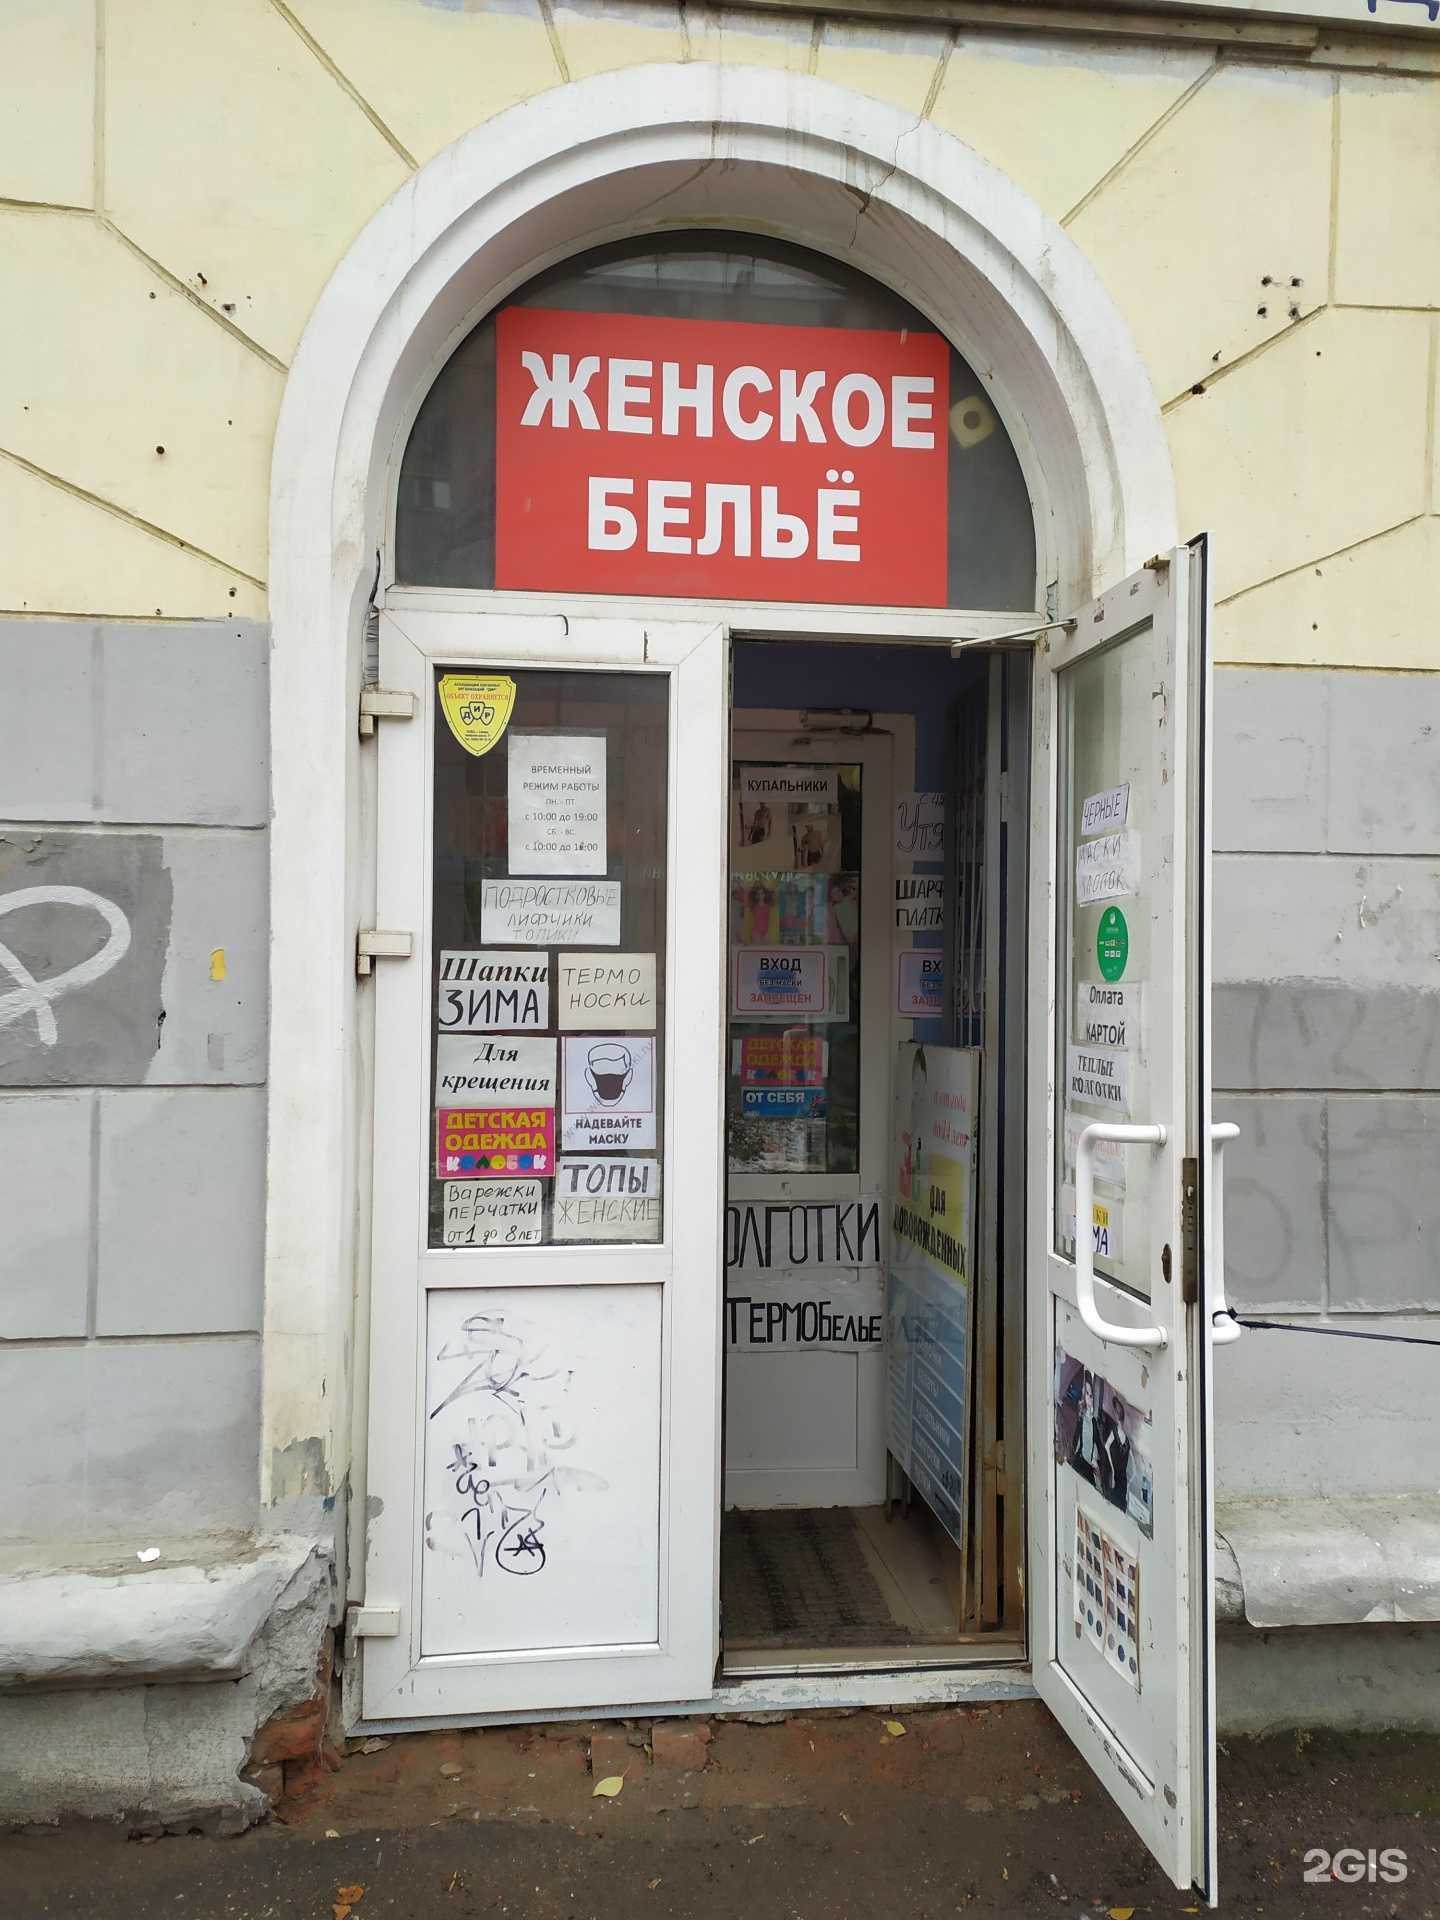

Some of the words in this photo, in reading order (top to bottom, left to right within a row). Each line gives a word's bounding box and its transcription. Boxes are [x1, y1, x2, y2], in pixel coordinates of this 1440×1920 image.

[520, 350, 935, 449] ЖЕНСКОЕ
[587, 469, 860, 562] БЕЛЬЁ
[531, 765, 592, 774] ВРЕМЕННЫЙ
[523, 782, 559, 791] РЕЖИМ
[561, 782, 600, 791] РАБОТЫ
[747, 780, 829, 792] КУПАЛЬНИКИ
[533, 812, 557, 821] 10:00
[559, 814, 571, 823] до
[574, 812, 598, 822] 19:00
[1084, 793, 1121, 827] ЧЕРНЫЕ
[533, 842, 557, 852] 10:00
[559, 845, 571, 853] до
[895, 880, 945, 900] ШАРФ
[507, 912, 593, 927] ЛИФЧИКИ
[896, 907, 945, 927] ПЛАТК
[440, 957, 549, 983] Шапки
[760, 958, 801, 973] ВХОД
[922, 960, 944, 973] ВХ
[562, 968, 641, 986] ТЕРМО
[569, 992, 651, 1010] НОСКИ
[1089, 986, 1124, 1005] Оплата
[438, 989, 539, 1026] ЗИМА
[1086, 1020, 1126, 1045] КАРТОЙ
[473, 1042, 519, 1064] Для
[1078, 1055, 1114, 1077] ТЕПЛЫЕ
[441, 1074, 550, 1093] крещения
[1072, 1076, 1122, 1101] КОЛГОТКИ
[745, 1092, 764, 1104] ОТ
[767, 1092, 805, 1105] СЕБЯ
[446, 1111, 546, 1130] ДЕТСКАЯ
[575, 1116, 643, 1130] НАДЕВАЙТЕ
[445, 1132, 547, 1151] ОДЕЖДА
[589, 1134, 629, 1145] МАСКУ
[446, 1154, 546, 1172] КОЛОБОК
[562, 1163, 649, 1194] ТОПЫ
[557, 1198, 660, 1225] ЖЕНСКИЕ
[465, 1223, 476, 1243] 1
[505, 1224, 517, 1242] 8
[726, 1203, 880, 1268] ОЛГОТКИ
[1092, 1226, 1109, 1256] МА
